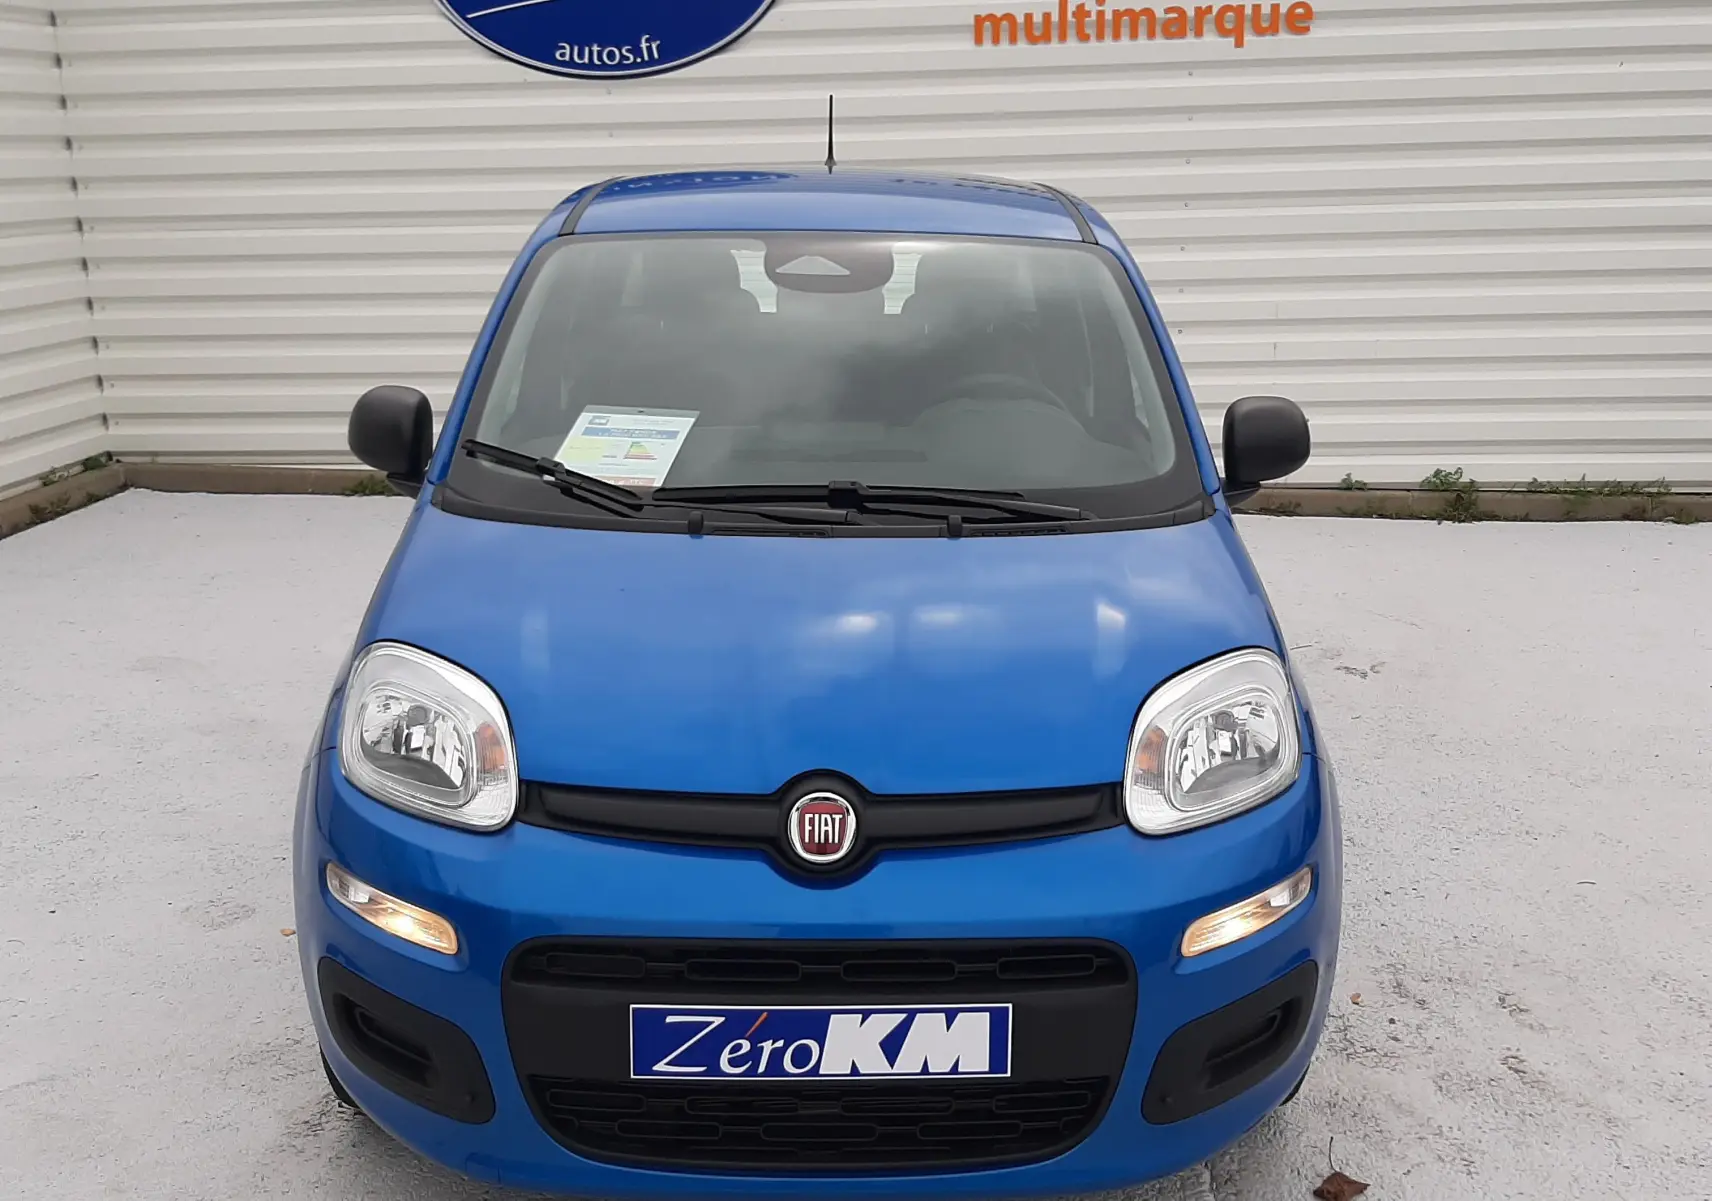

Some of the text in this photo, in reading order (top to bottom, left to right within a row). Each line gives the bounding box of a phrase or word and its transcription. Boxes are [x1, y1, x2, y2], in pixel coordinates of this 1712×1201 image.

[974, 0, 1313, 48] multimarque
[555, 34, 660, 65] autos.fr
[804, 813, 843, 844] FIAT
